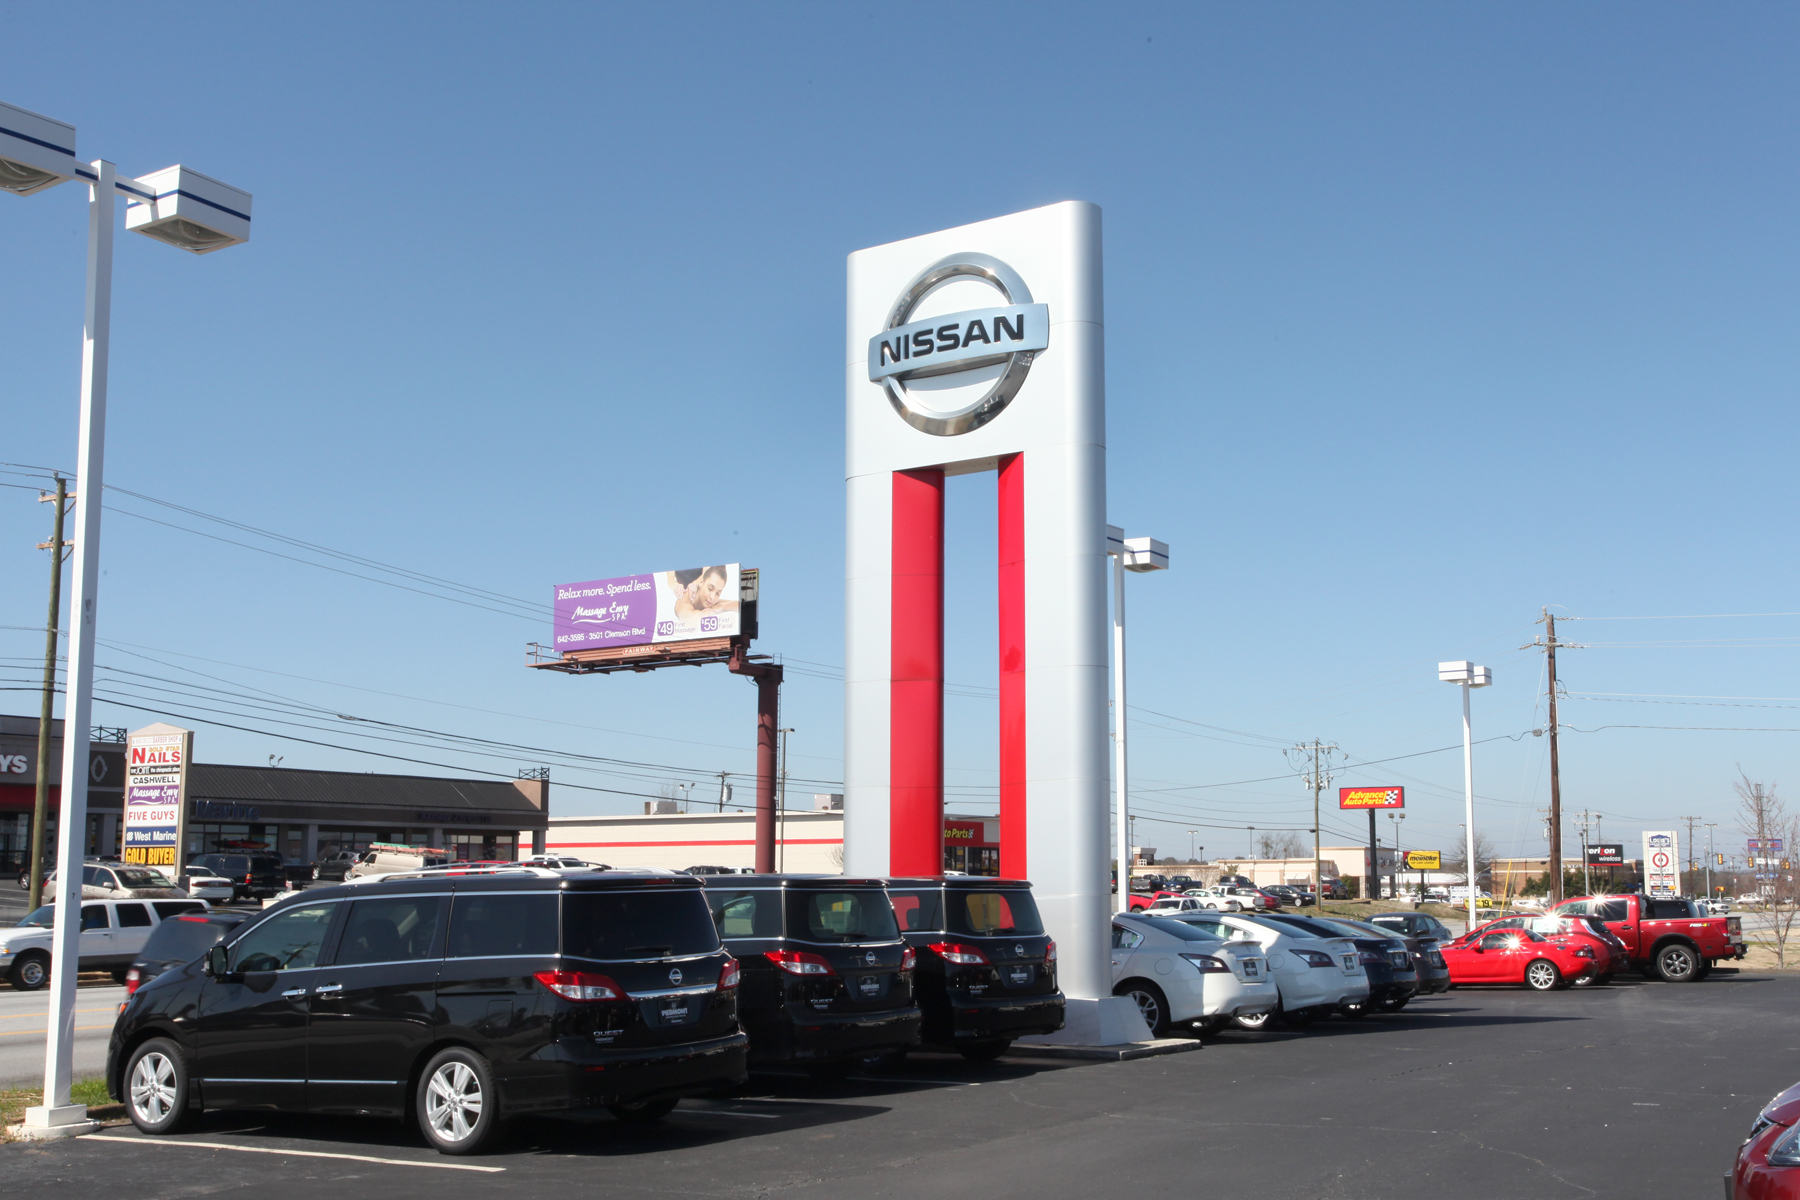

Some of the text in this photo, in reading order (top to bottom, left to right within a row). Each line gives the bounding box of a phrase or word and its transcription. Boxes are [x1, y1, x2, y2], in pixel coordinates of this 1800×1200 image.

[880, 313, 1024, 367] NISSAN
[558, 579, 651, 600] Relax more. Spend less.
[571, 602, 629, 620] Massage Envy
[658, 622, 673, 635] $49
[701, 617, 717, 631] $59
[557, 627, 646, 643] 642-3595 3501 Clemson Blvd
[624, 646, 654, 654] FAIRWAY
[131, 747, 181, 764] NAILS
[133, 776, 176, 784] CASHWELL
[130, 786, 179, 799] Massage Envy
[1347, 791, 1384, 799] Advance
[128, 810, 174, 821] FIVE GUYS
[195, 800, 261, 820] Marine
[134, 830, 177, 841] West Marine
[952, 828, 969, 838] Parts
[125, 847, 175, 865] GOLD BUYER
[1482, 899, 1490, 908] 19
[661, 1007, 688, 1016] PIEDMONT
[593, 1029, 624, 1037] QUEST
